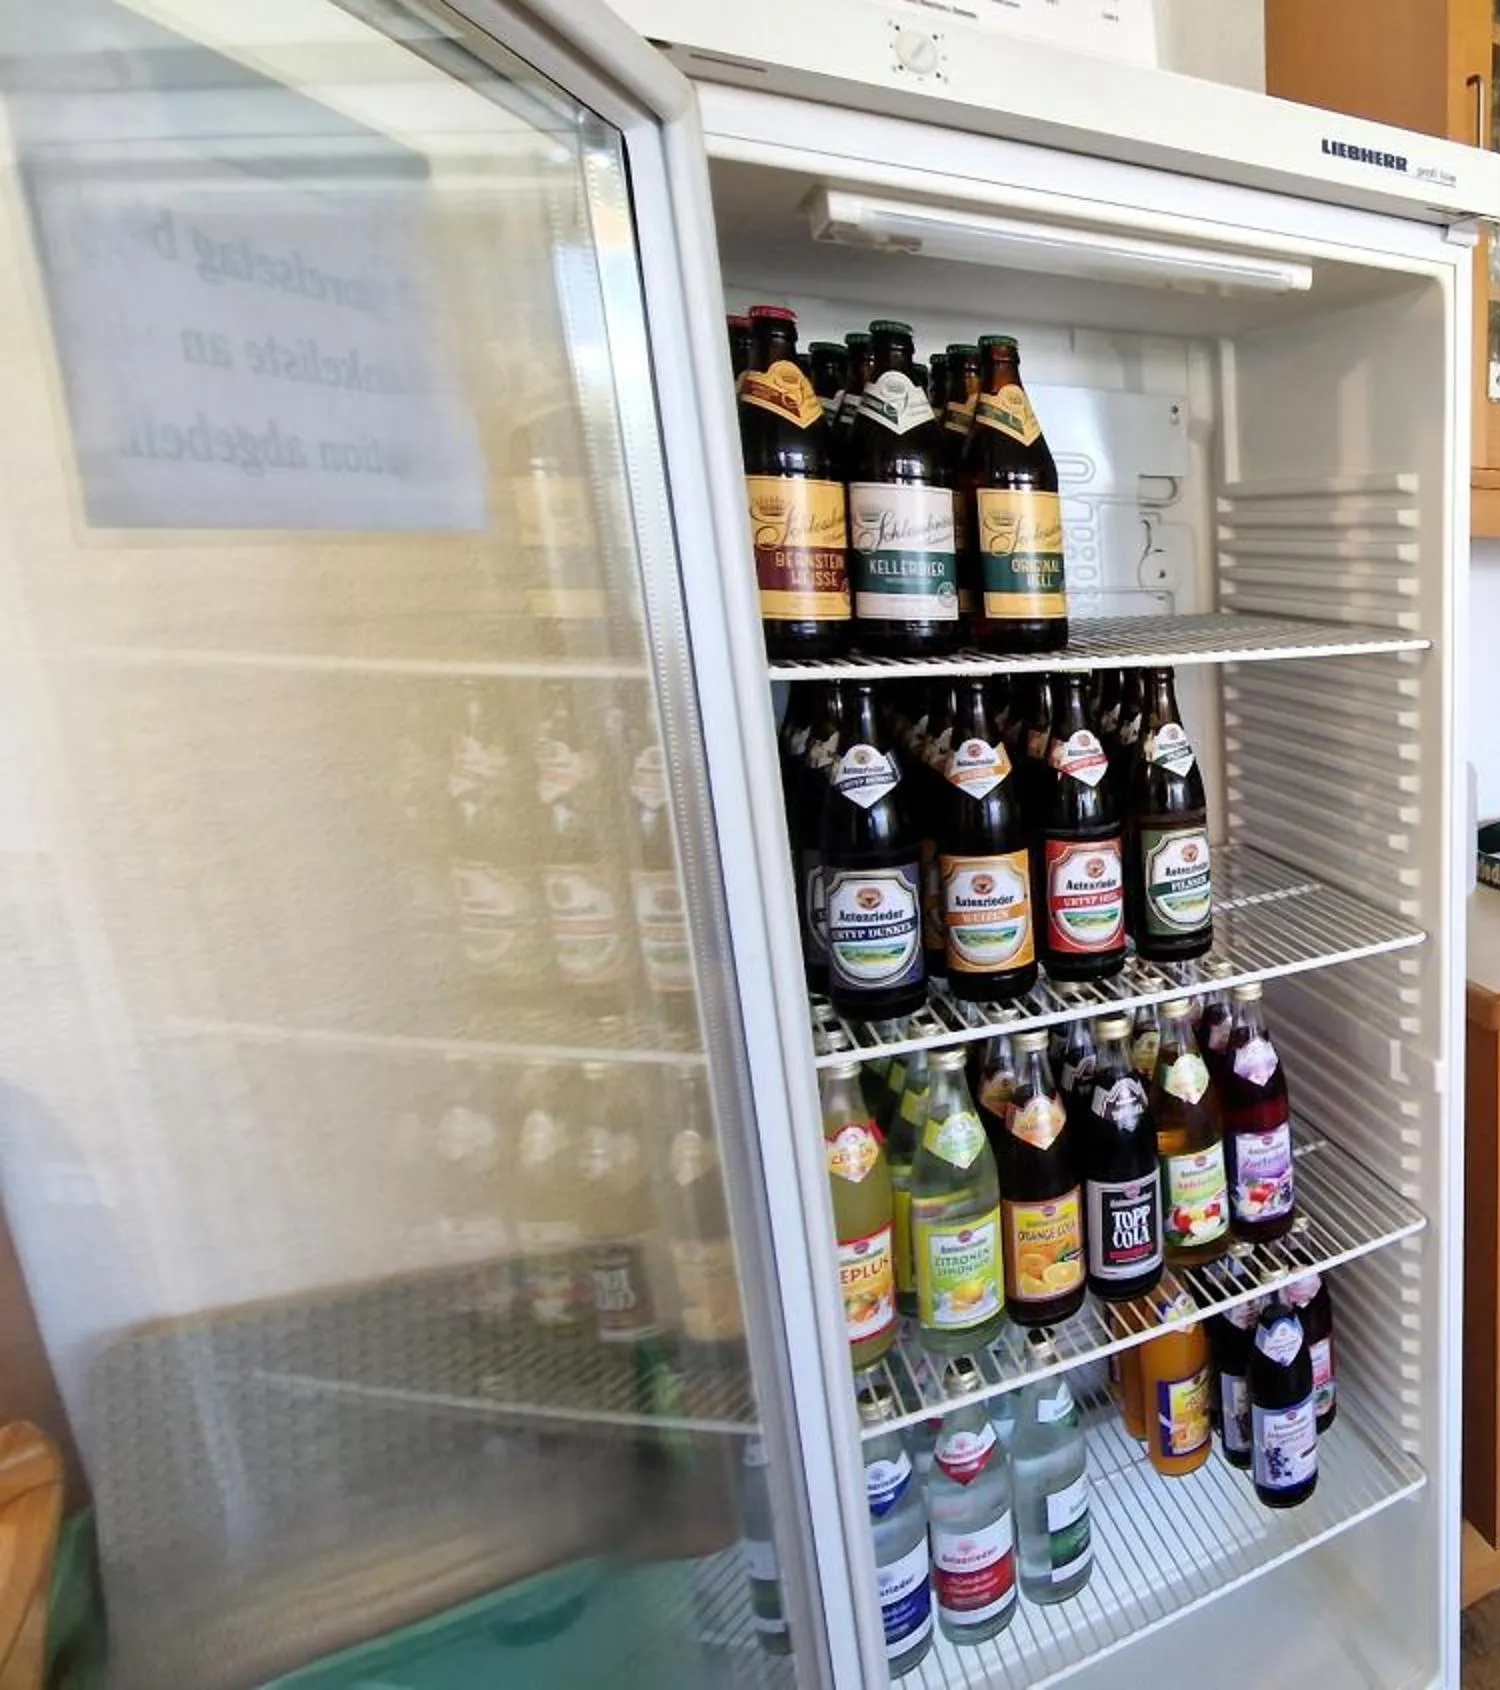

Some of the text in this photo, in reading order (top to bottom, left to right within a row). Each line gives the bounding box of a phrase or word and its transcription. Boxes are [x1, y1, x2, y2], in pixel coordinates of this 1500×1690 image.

[1321, 138, 1408, 172] LIEBHERR
[868, 558, 946, 578] KELLERBIER
[1111, 1205, 1151, 1231] TOPP
[1113, 1226, 1151, 1249] COLA
